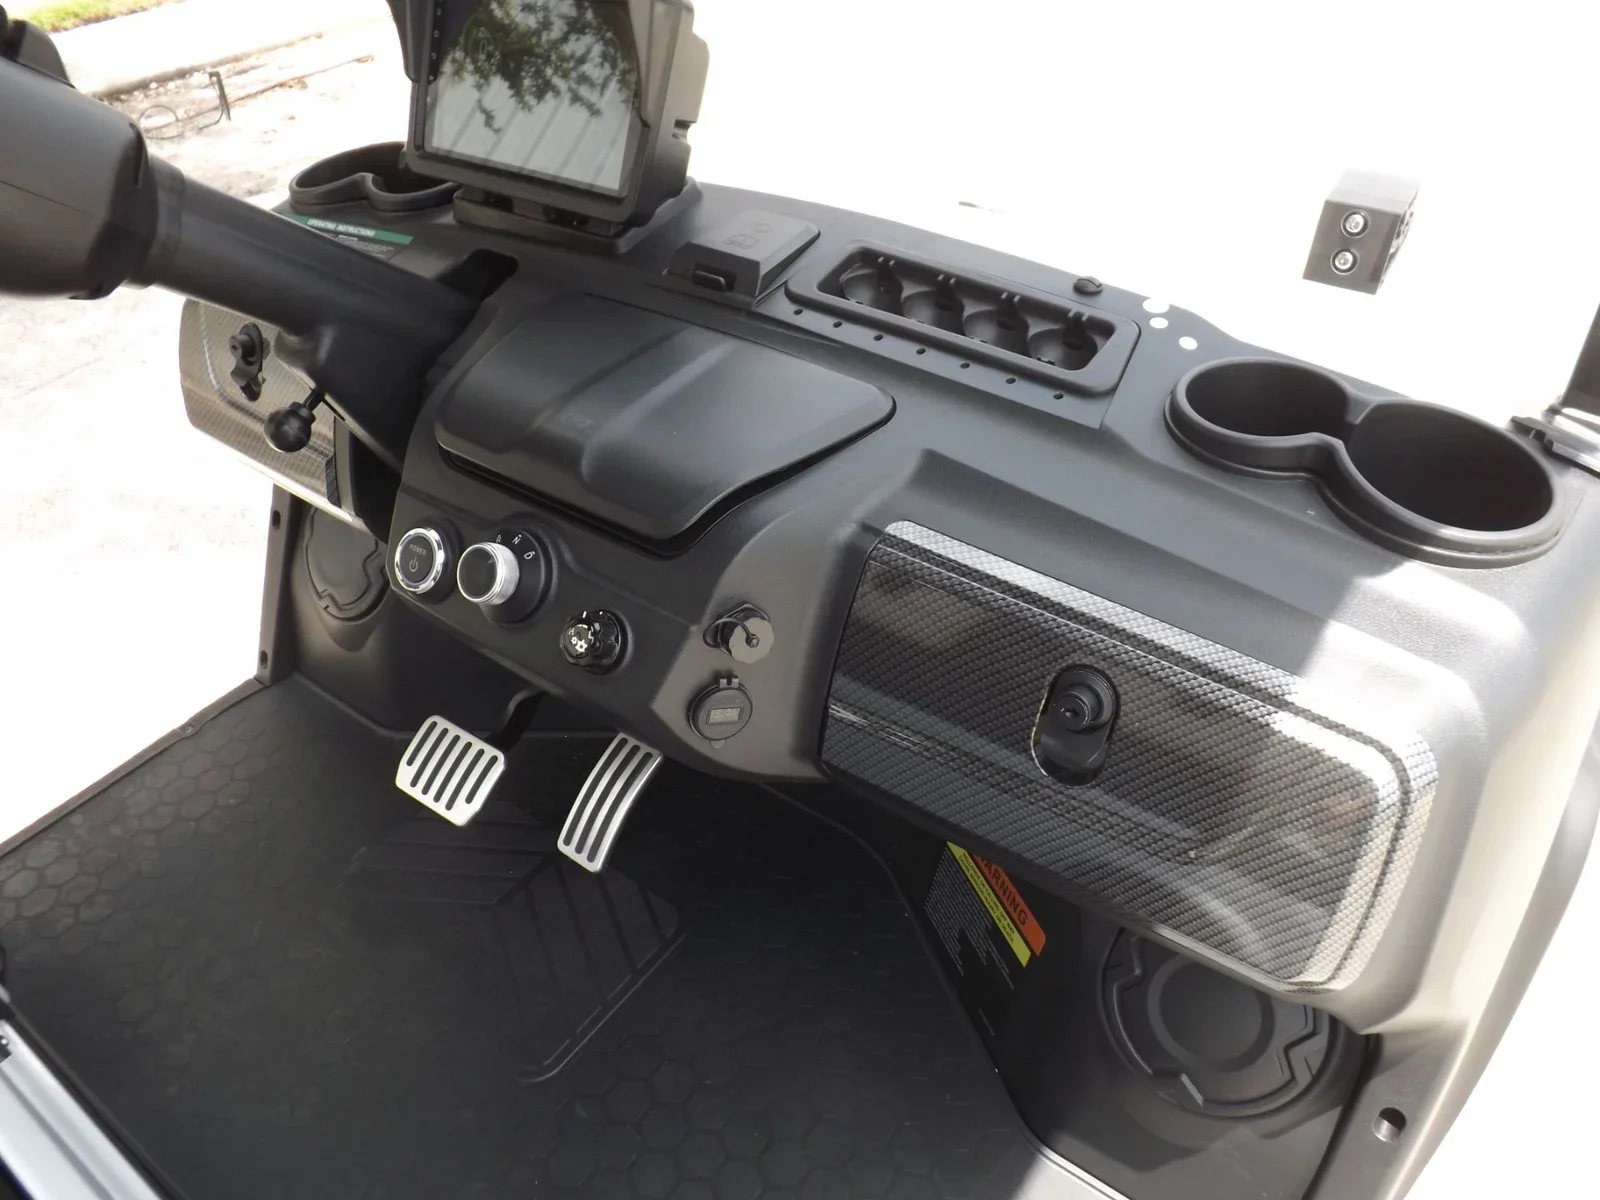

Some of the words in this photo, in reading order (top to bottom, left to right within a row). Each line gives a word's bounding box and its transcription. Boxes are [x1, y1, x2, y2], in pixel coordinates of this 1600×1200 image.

[307, 218, 336, 230] OPERATING
[337, 225, 376, 237] INSTRUCTIONS
[511, 536, 521, 544] N
[409, 543, 426, 556] POWER
